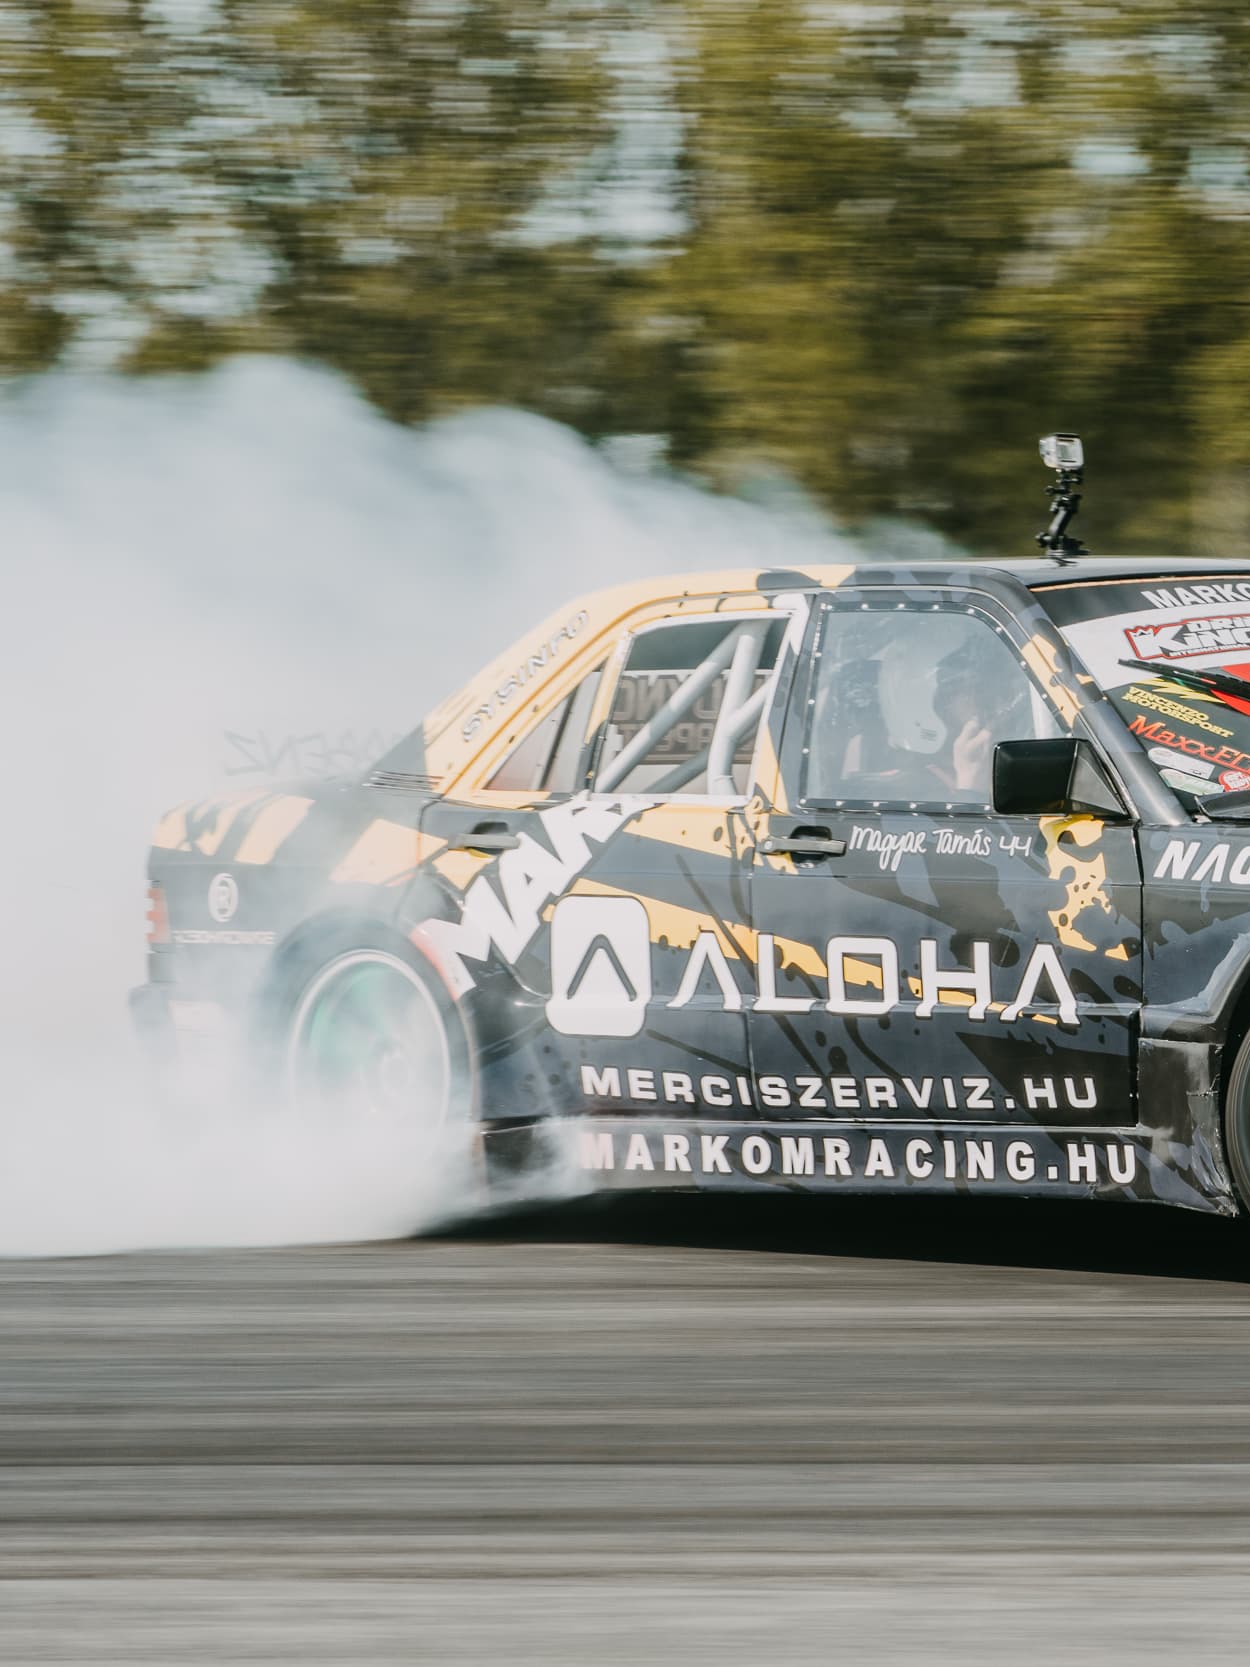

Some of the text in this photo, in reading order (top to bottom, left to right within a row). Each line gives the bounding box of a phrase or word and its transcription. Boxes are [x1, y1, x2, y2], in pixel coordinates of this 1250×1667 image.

[1121, 693, 1235, 738] MOTORSPORT
[1127, 685, 1210, 722] VINCENZO
[850, 826, 1031, 871] Magyar Tamás 44
[667, 930, 1080, 1025] ALOHA
[580, 1065, 1098, 1110] MERCISZERVIZ.HU
[578, 1132, 1136, 1184] MARKOMRACING.HU
